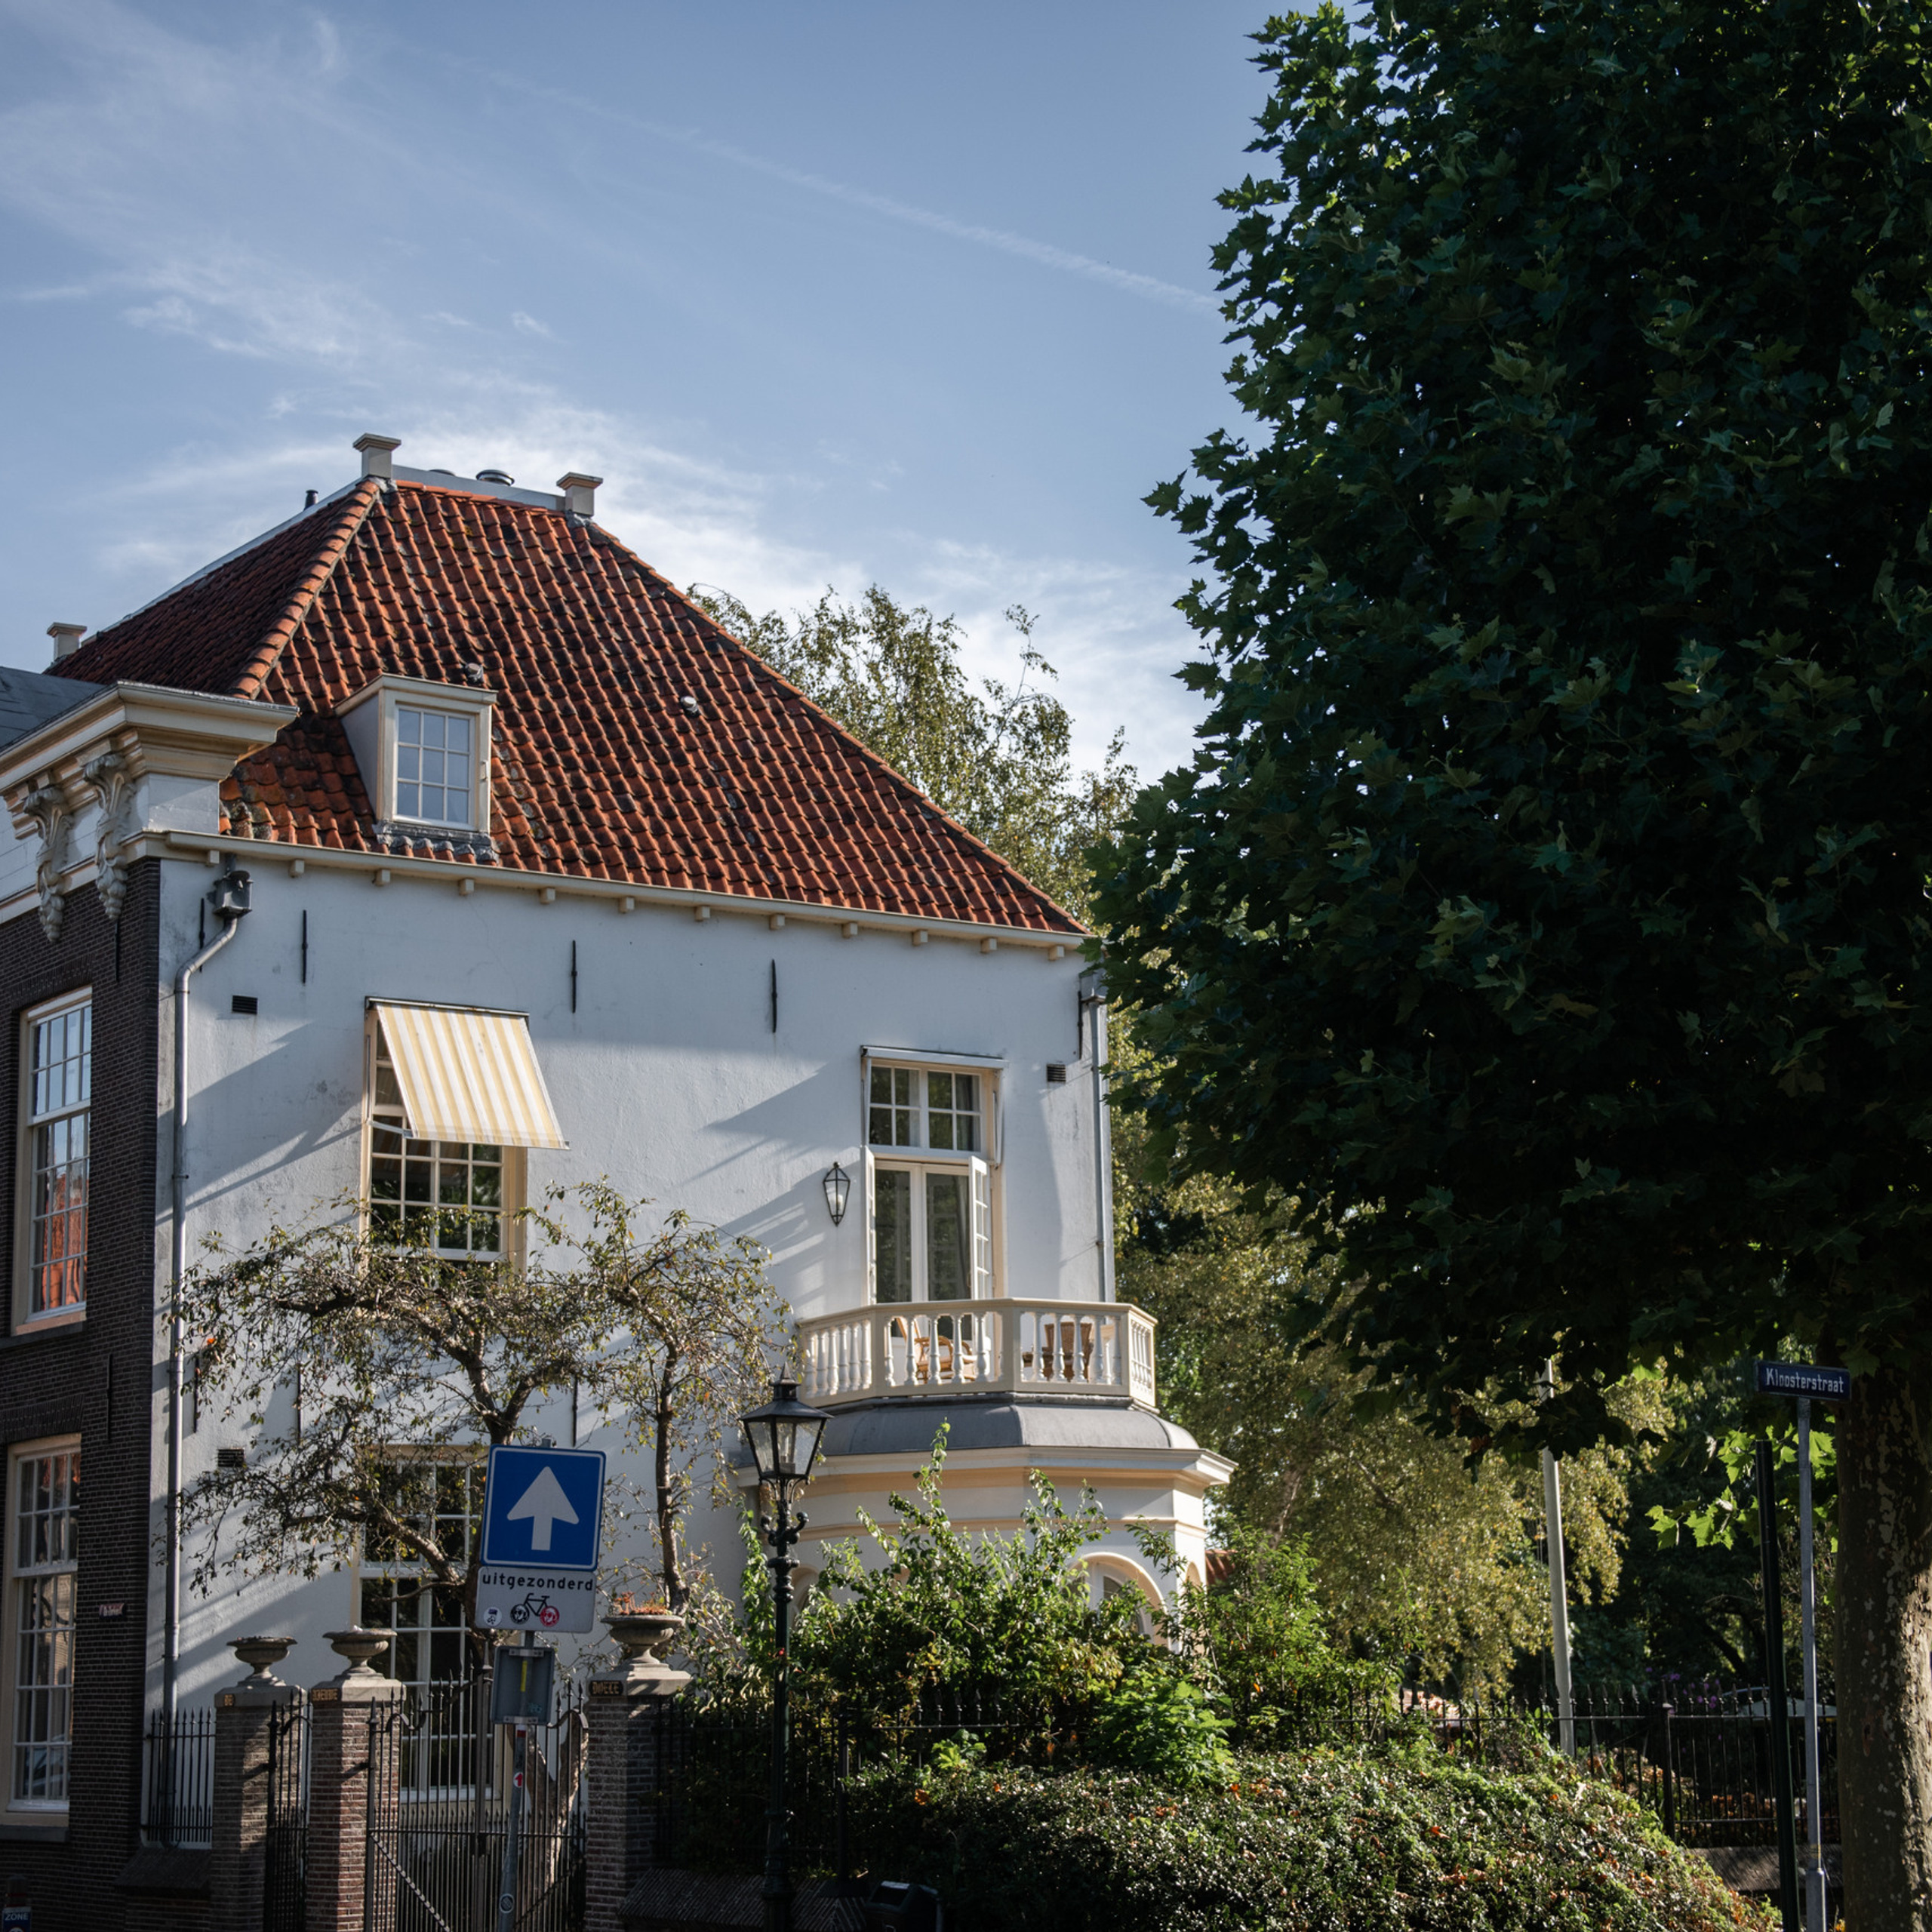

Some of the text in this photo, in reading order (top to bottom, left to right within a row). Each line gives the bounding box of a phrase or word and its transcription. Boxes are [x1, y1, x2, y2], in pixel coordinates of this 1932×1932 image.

[1765, 1367, 1844, 1393] Kloosterstraat
[482, 1572, 593, 1591] uitgezonderd
[5, 1912, 29, 1921] ZONE
